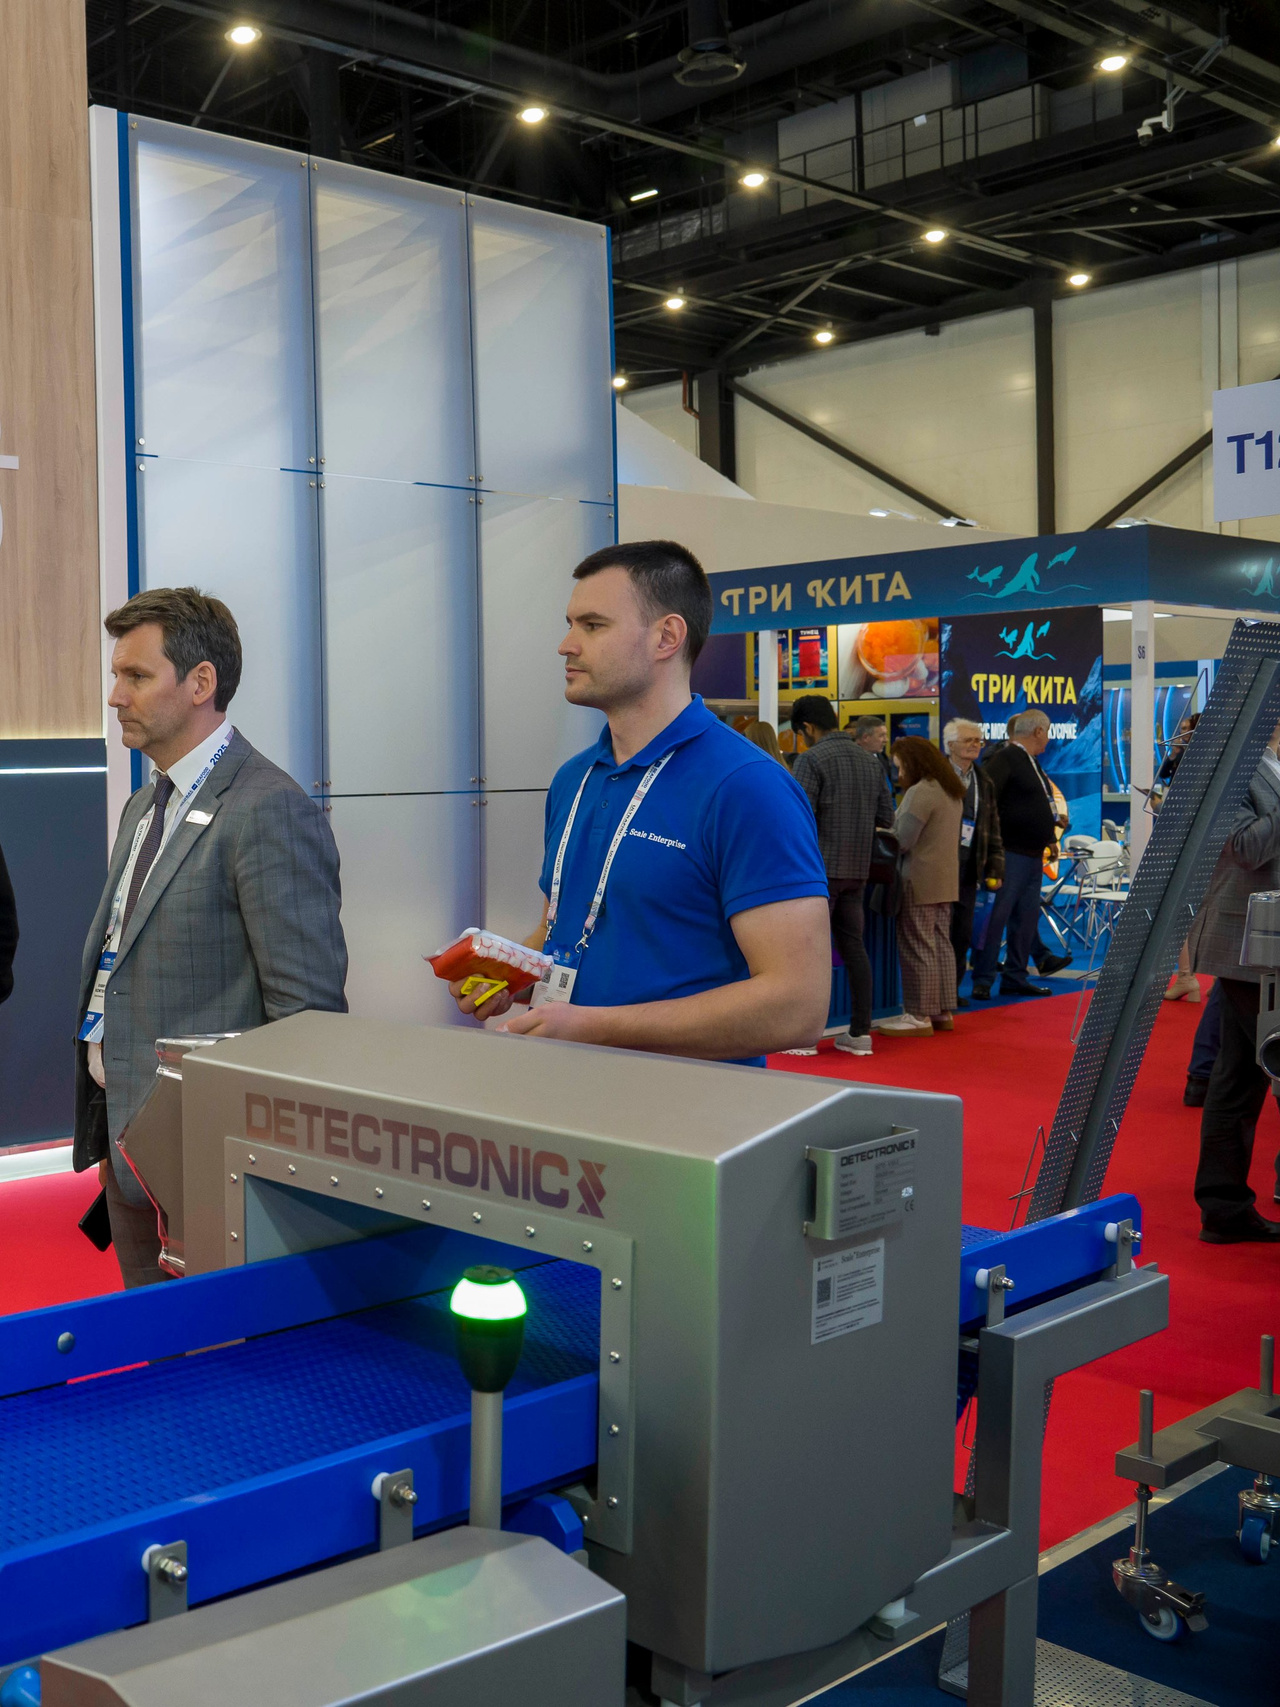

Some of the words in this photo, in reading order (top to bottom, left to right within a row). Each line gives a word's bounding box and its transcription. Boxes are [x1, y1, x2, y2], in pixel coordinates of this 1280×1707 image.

[1227, 430, 1280, 474] T1
[721, 582, 792, 616] ТРИ
[806, 571, 912, 608] КИТА
[971, 673, 1015, 703] ТРИ
[1022, 675, 1077, 705] КИТА
[210, 744, 228, 766] 2025
[629, 828, 648, 839] Scale
[648, 832, 686, 850] Enterprise
